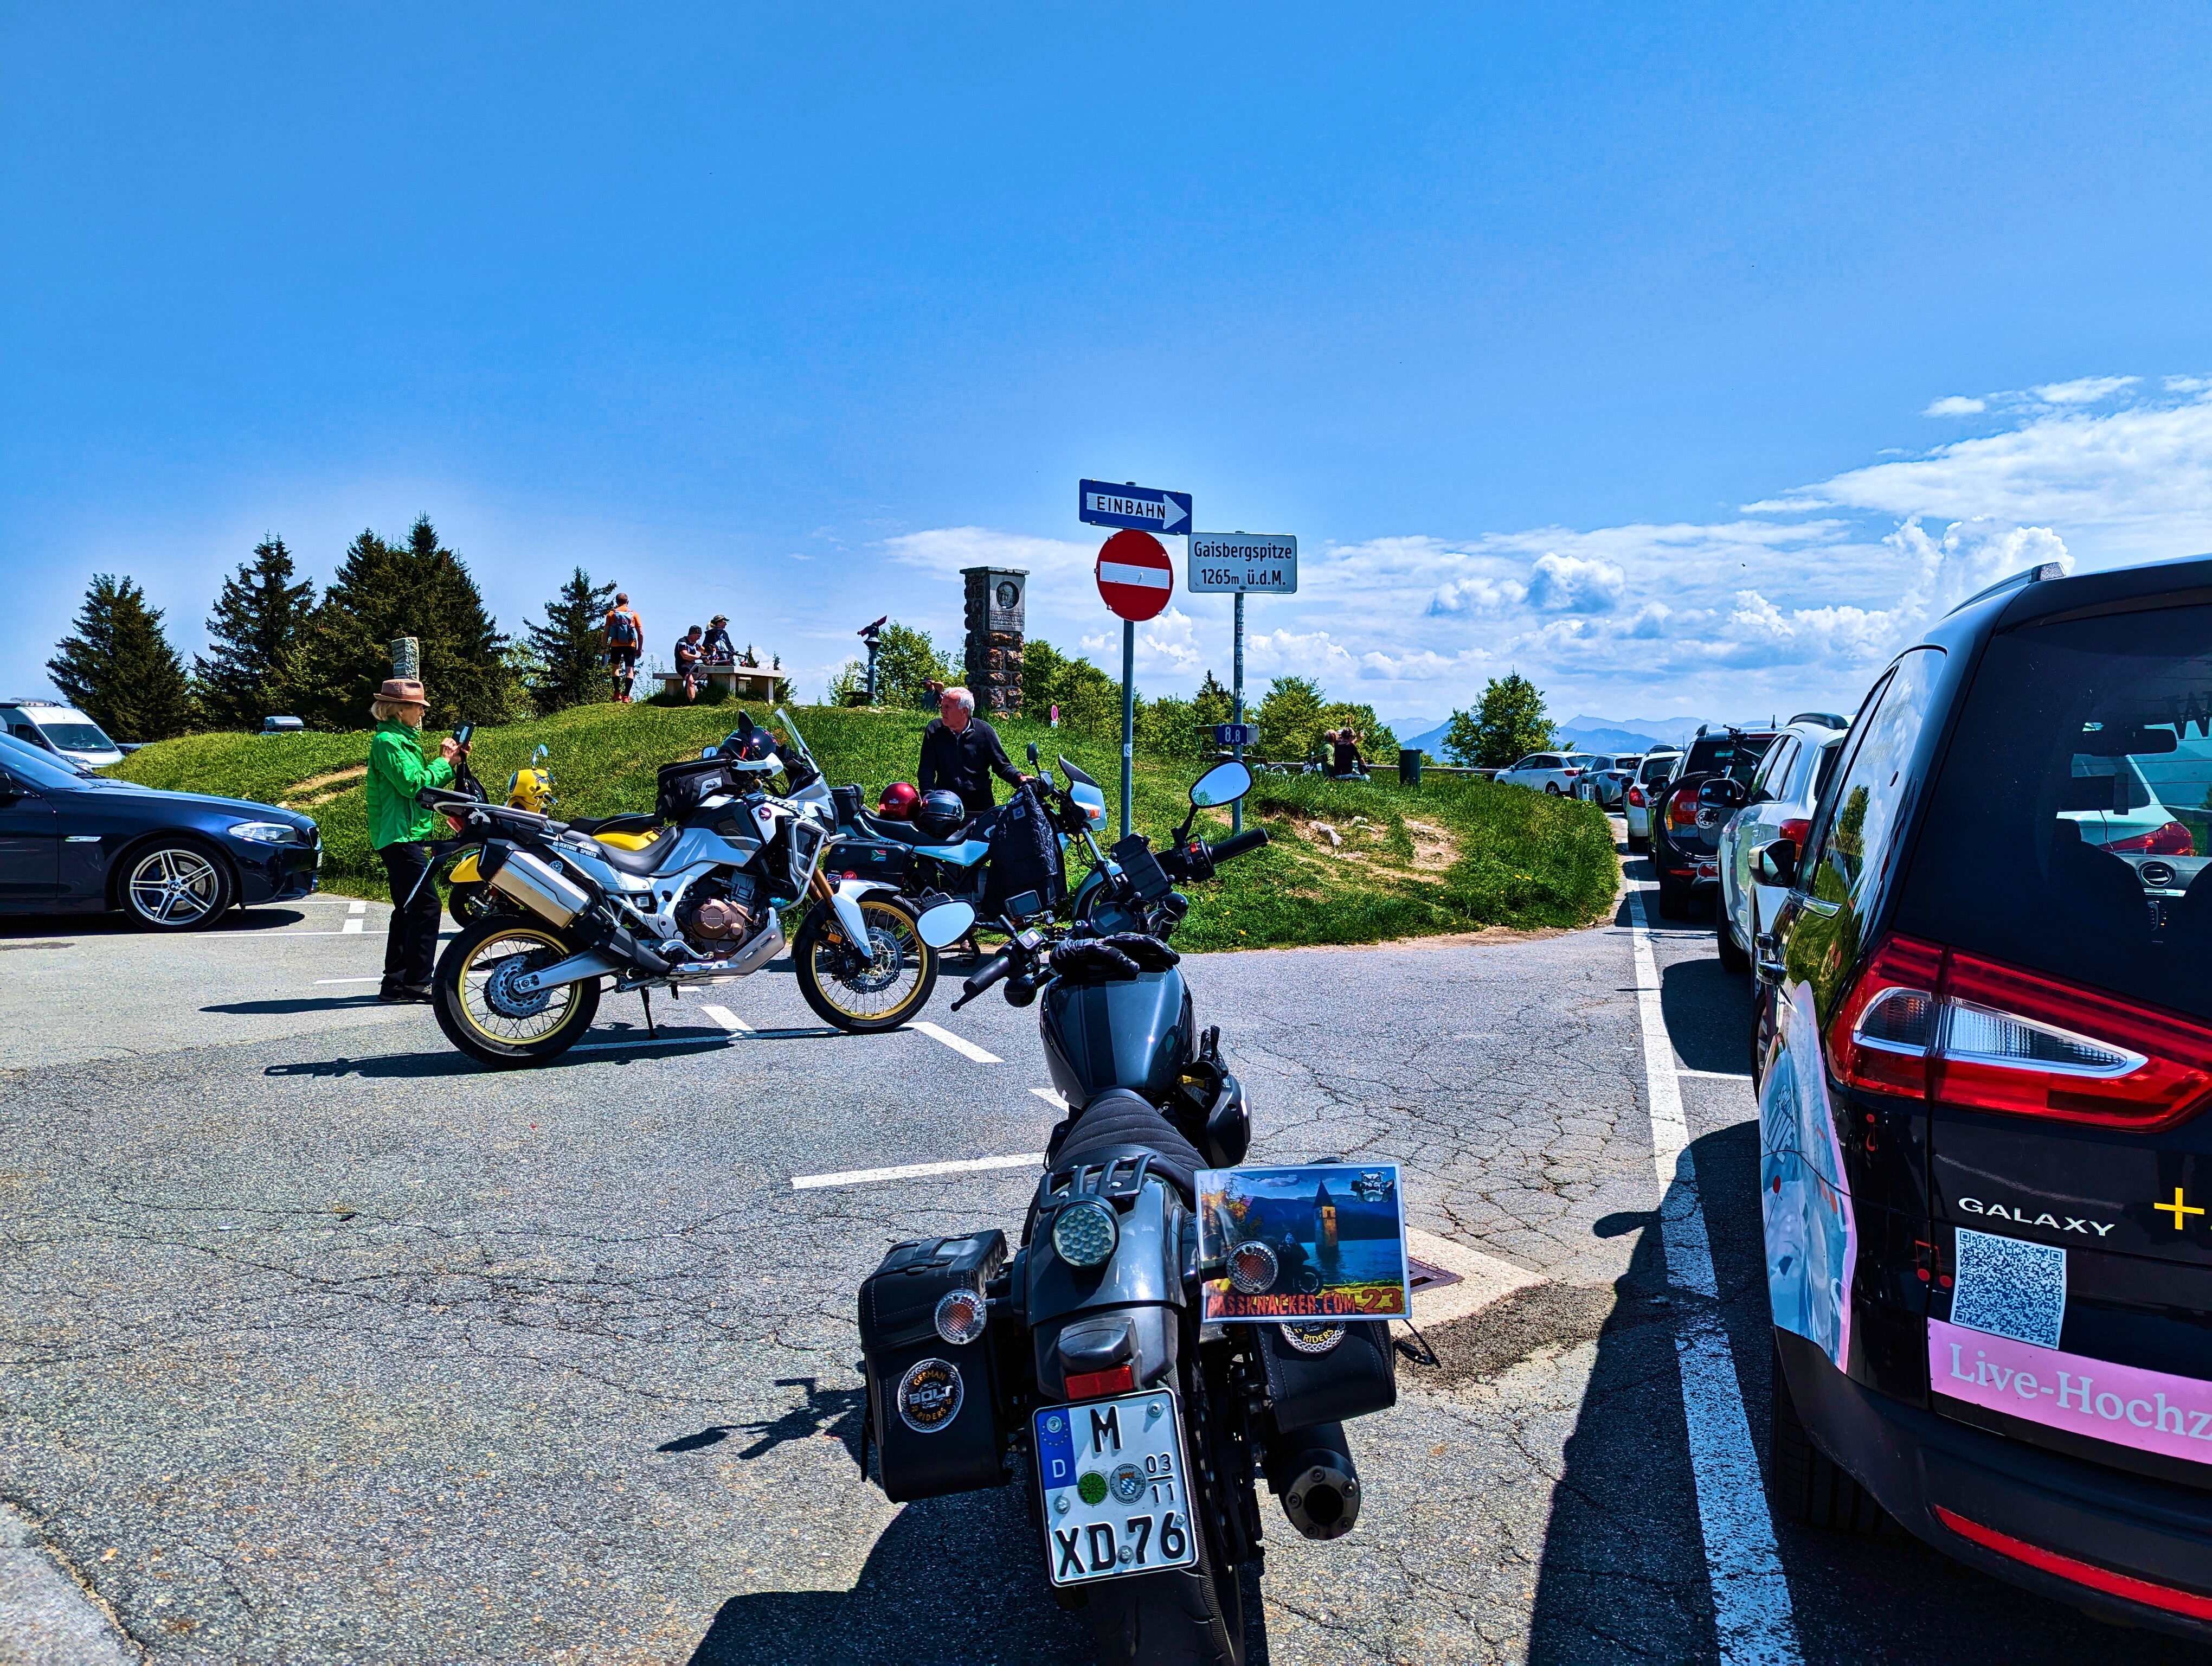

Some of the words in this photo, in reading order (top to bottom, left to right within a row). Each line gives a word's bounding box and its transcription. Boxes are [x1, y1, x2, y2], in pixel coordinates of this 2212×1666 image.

[1096, 496, 1166, 520] EINBAHN
[1194, 541, 1292, 562] Gaisbergspitze
[1201, 569, 1239, 585] 1265m
[1247, 568, 1286, 586] ü.d.M.
[1225, 726, 1240, 744] 8,8
[552, 841, 578, 851] ADVENTURE
[580, 848, 597, 858] SPORTS
[1958, 1197, 2115, 1236] GALAXY
[1207, 1293, 1356, 1318] PASSKNACKER.COM
[1361, 1288, 1403, 1314] 23
[1303, 1329, 1334, 1343] RIDERS
[913, 1370, 946, 1385] GERMAN
[909, 1385, 954, 1405] BOLT
[1950, 1343, 2212, 1441] Live-Hochz
[916, 1407, 947, 1421] RIDERS
[1090, 1405, 1122, 1453] M
[1052, 1459, 1066, 1478] D
[1146, 1453, 1172, 1473] 03
[1151, 1483, 1175, 1504] 11
[1054, 1522, 1117, 1577] XD
[1127, 1512, 1186, 1565] 76
